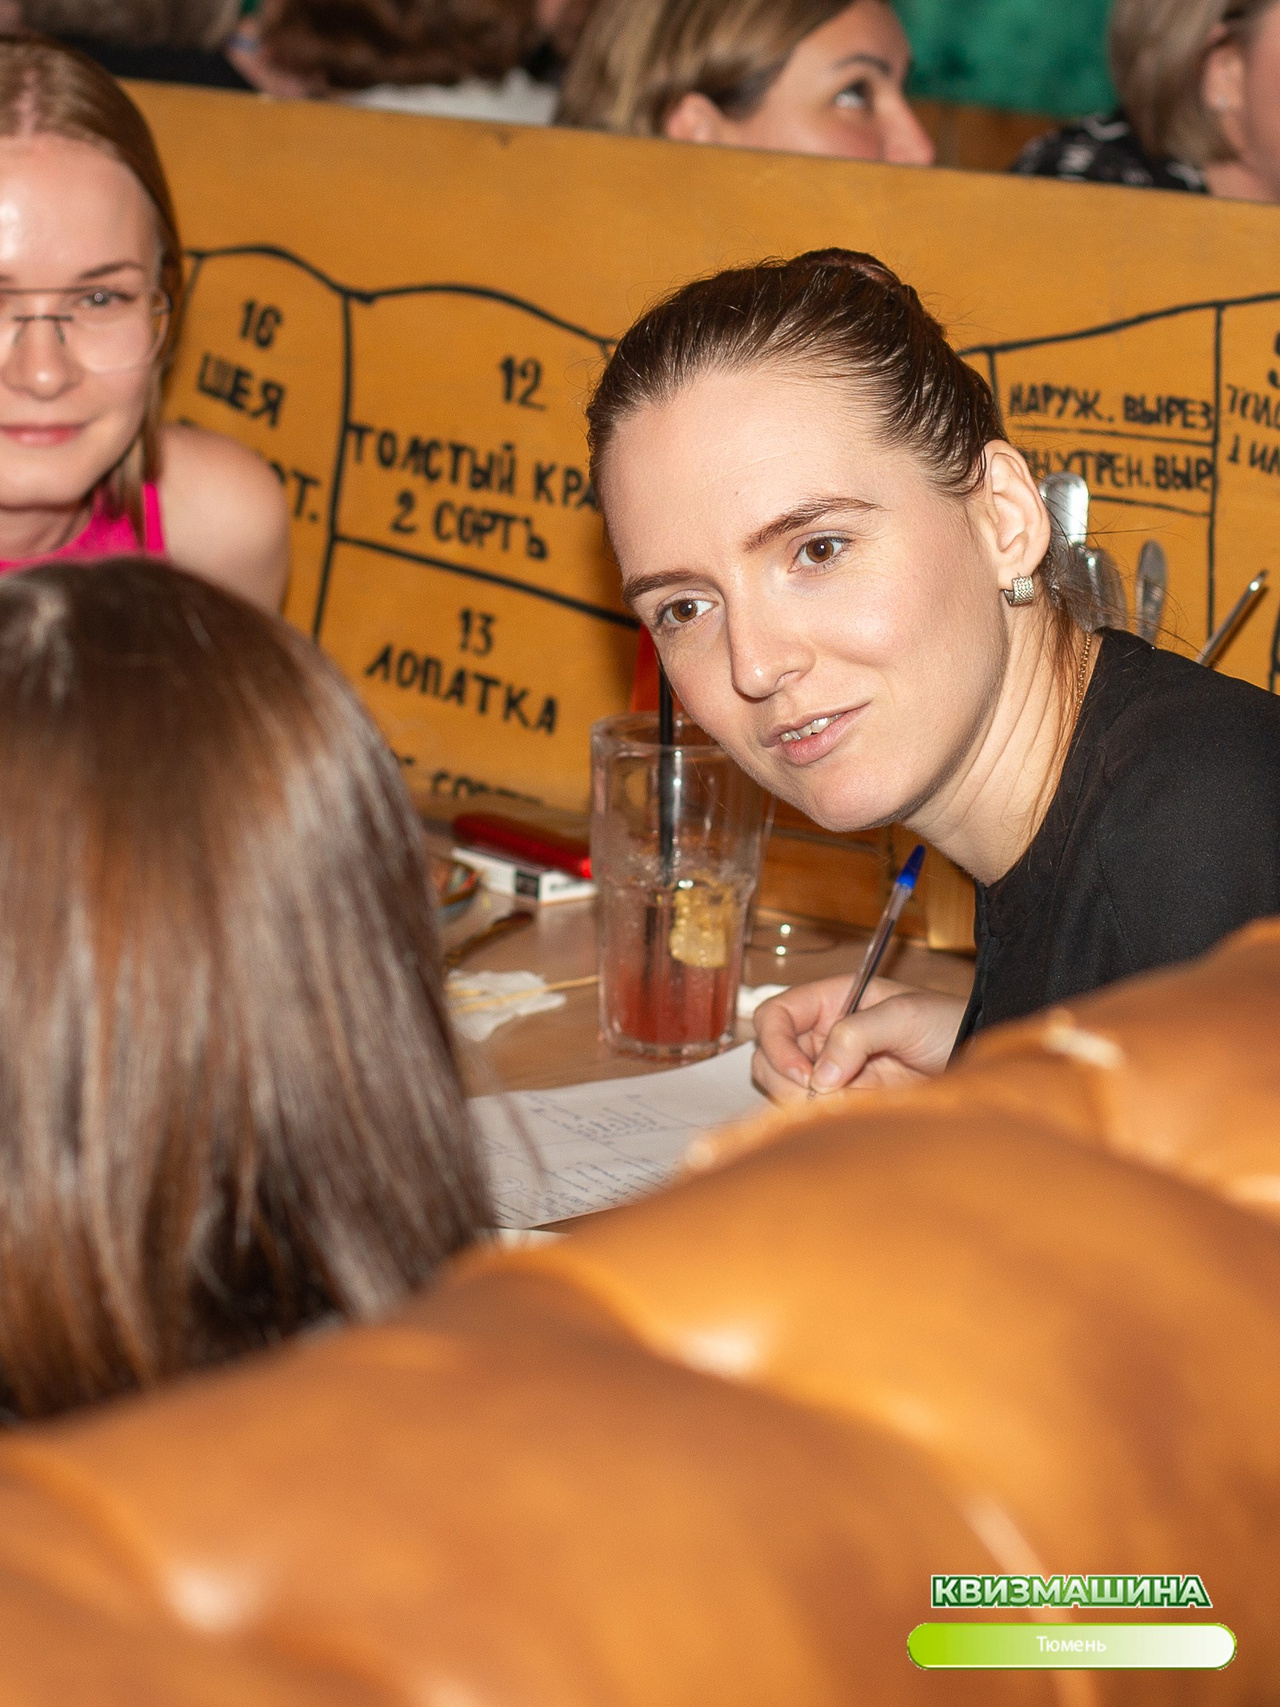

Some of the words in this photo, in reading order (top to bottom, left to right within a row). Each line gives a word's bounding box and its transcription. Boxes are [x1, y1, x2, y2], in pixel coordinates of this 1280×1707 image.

[197, 351, 286, 429] ШЕЯ
[500, 354, 547, 412] 12
[1008, 382, 1116, 424] НАРУЖ.
[1122, 393, 1214, 432] ВЫРЕЗ
[346, 422, 518, 497] ТОЛСТЫЙ
[390, 491, 417, 536] 2
[432, 501, 550, 562] СОРТЪ
[458, 607, 498, 657] 13
[364, 642, 558, 737] ЛОПАТКА
